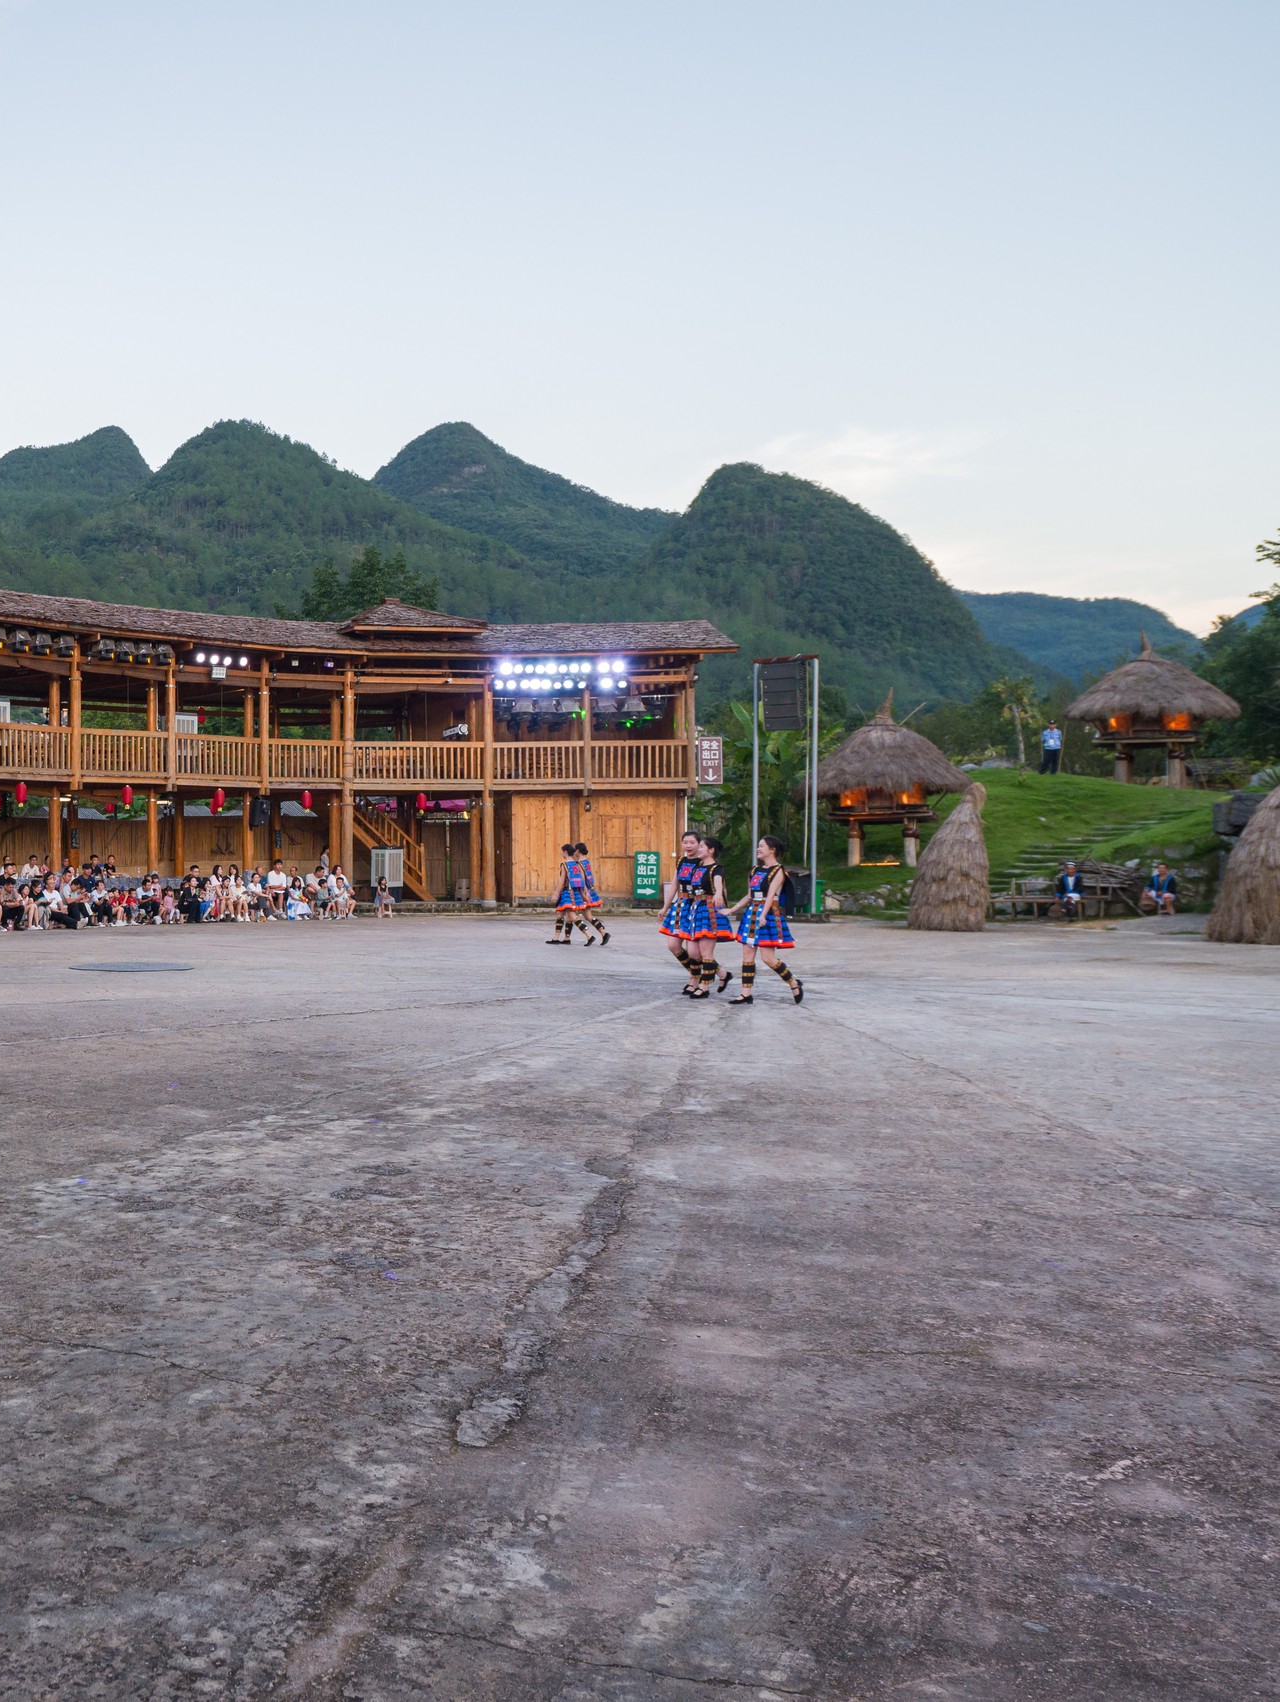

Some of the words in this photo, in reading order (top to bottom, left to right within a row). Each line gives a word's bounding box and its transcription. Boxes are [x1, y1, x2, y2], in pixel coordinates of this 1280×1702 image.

[701, 740, 719, 750] 安全
[702, 750, 719, 759] 出口
[637, 853, 657, 864] 安全
[637, 865, 657, 876] 出口
[637, 877, 657, 885] EXIT
